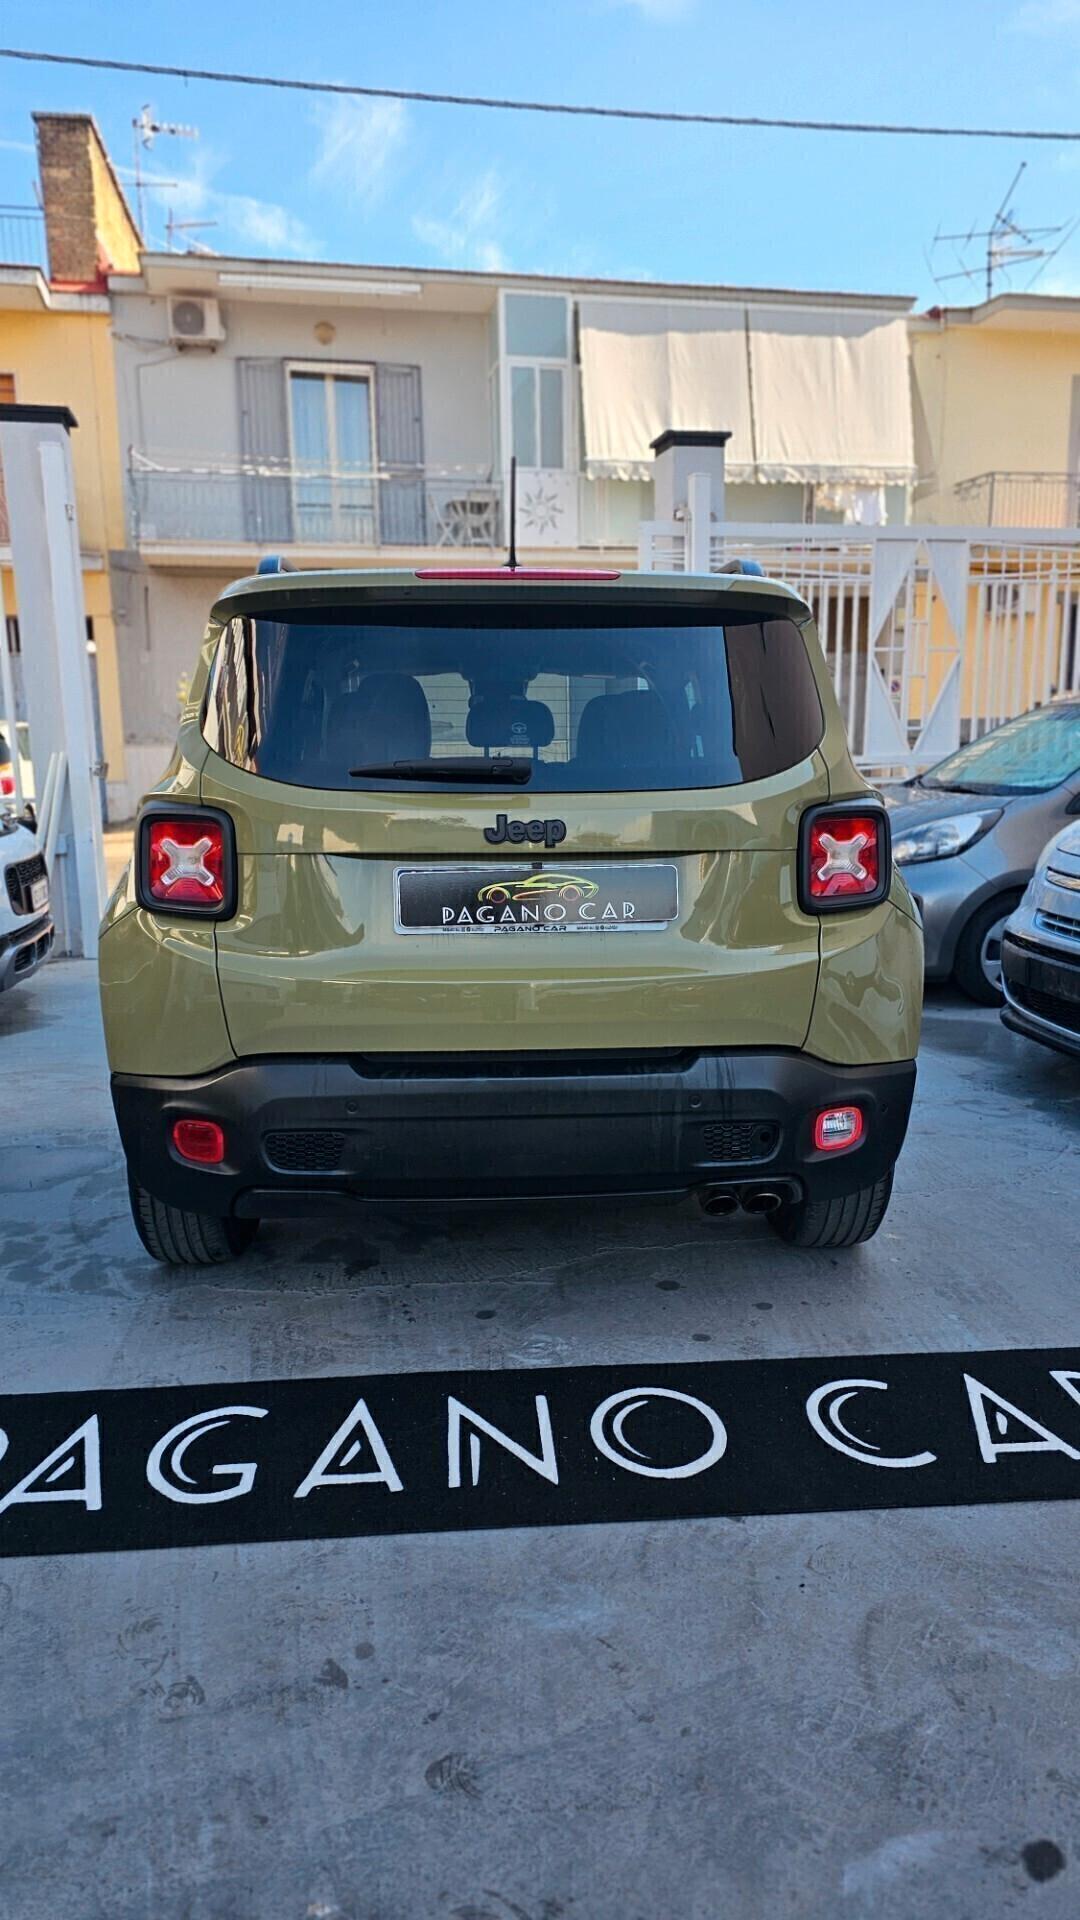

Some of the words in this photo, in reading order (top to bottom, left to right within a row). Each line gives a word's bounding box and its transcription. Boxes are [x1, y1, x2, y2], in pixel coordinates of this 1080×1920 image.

[484, 814, 566, 848] Jeep
[442, 903, 566, 924] PAGANO
[579, 901, 635, 920] CAR
[0, 1387, 727, 1513] AGANO
